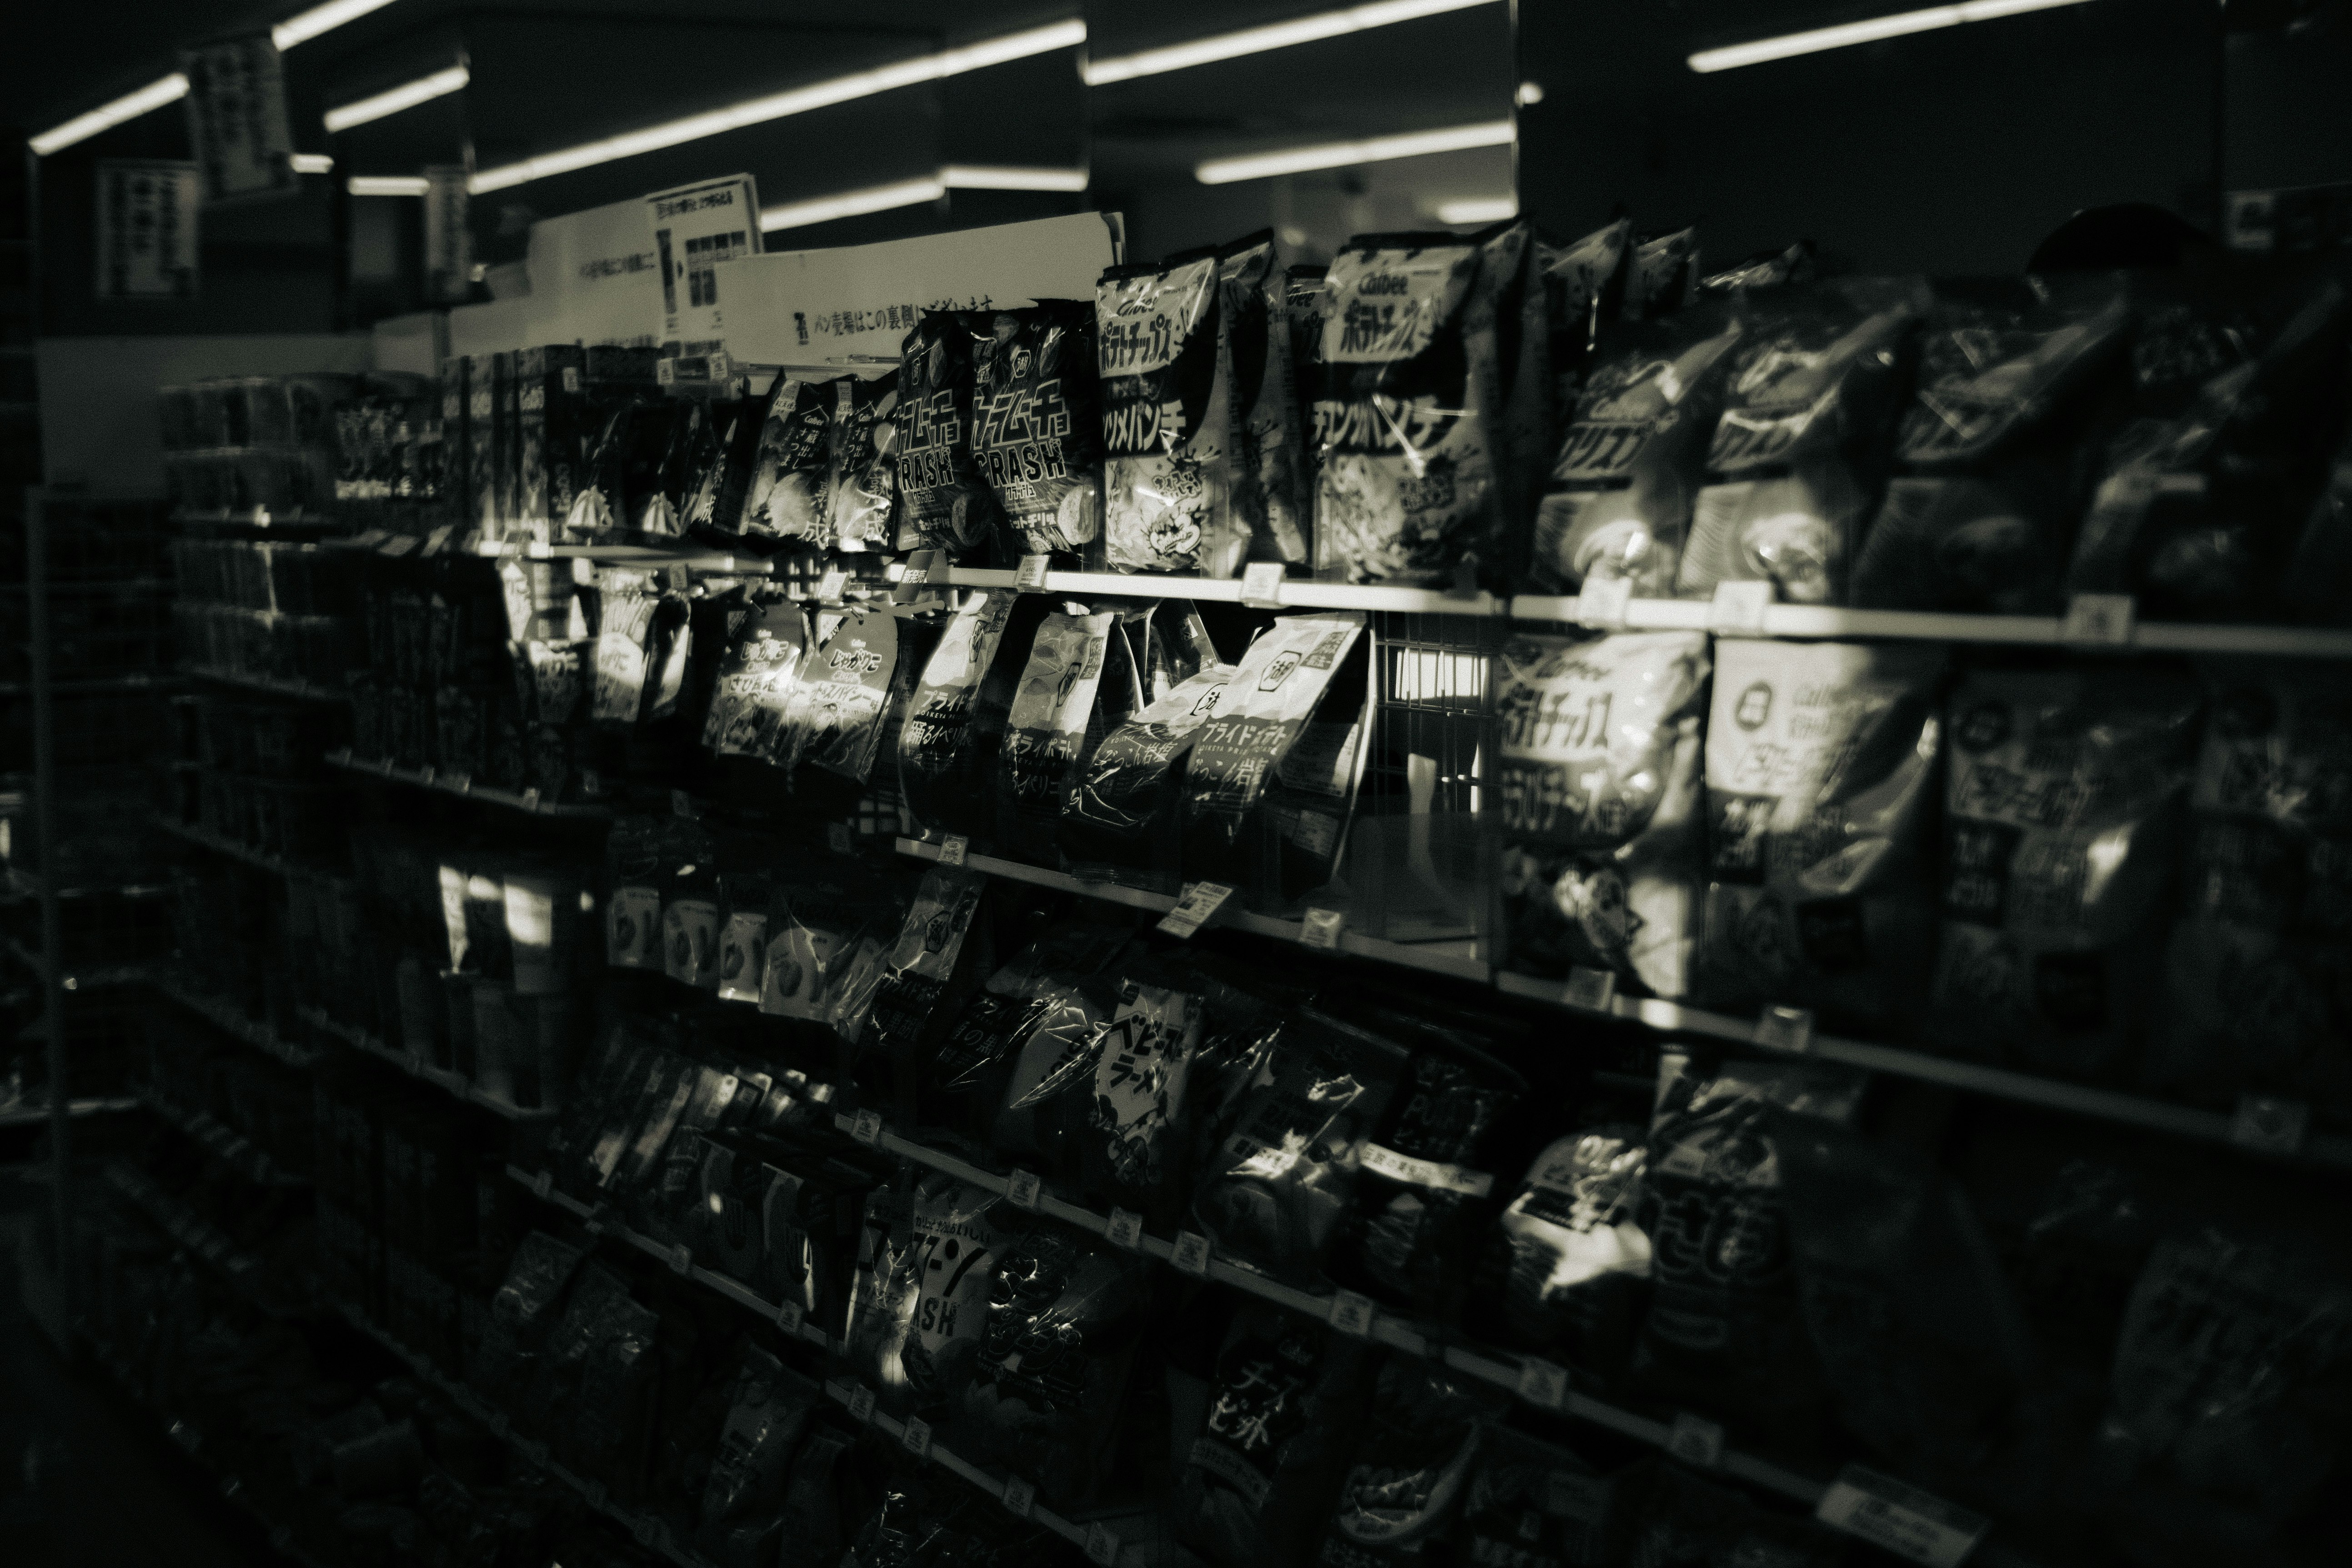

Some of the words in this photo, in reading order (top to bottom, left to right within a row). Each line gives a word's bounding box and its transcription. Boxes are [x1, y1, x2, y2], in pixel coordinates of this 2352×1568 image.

[1100, 314, 1173, 371] ポテトチップス
[897, 446, 955, 493] RASH
[901, 569, 927, 584] 新発売
[829, 648, 882, 672] じゃがりこ
